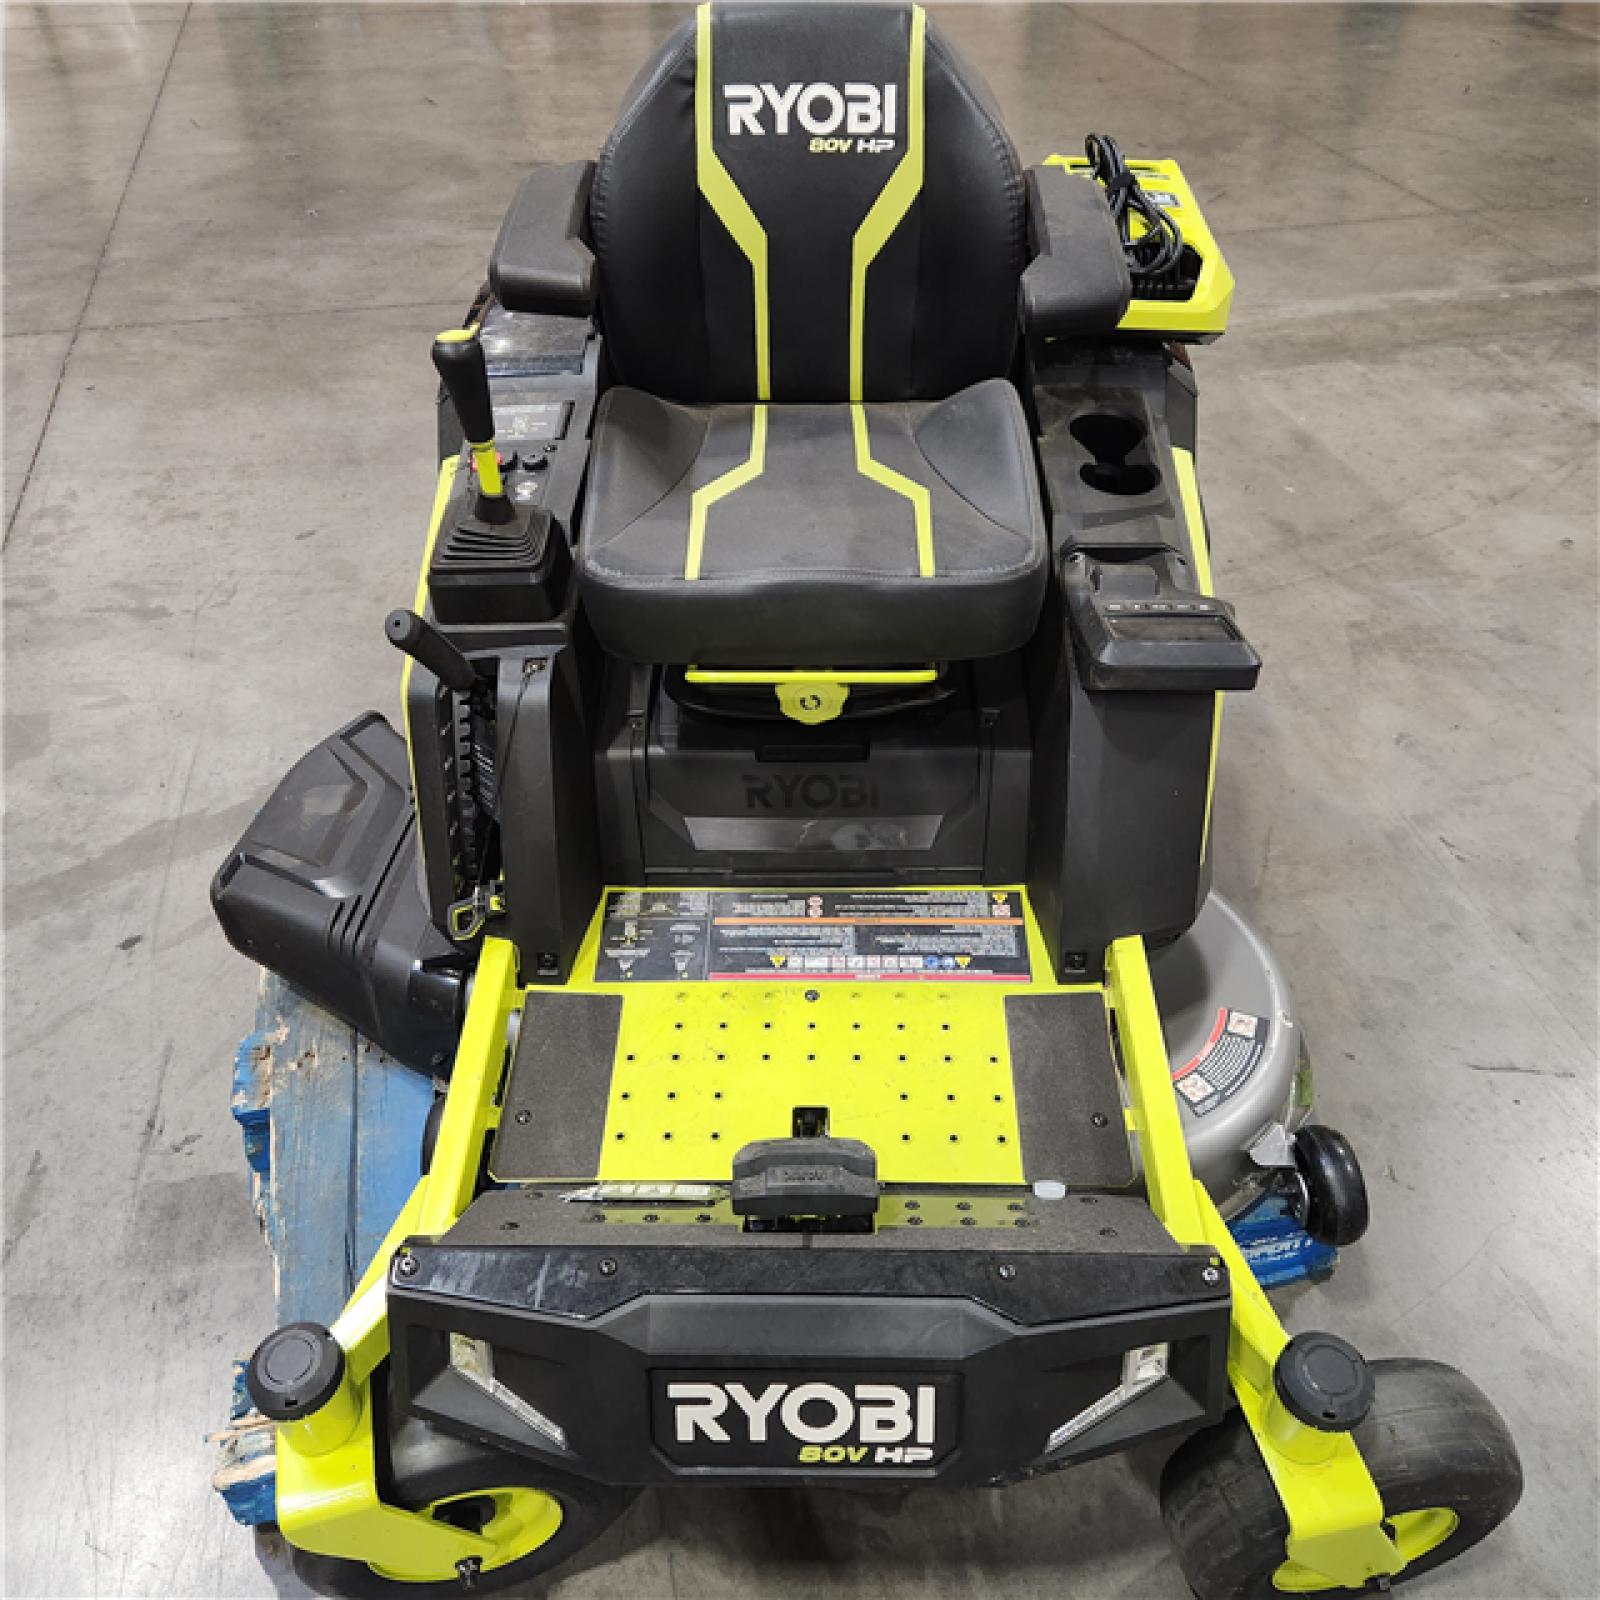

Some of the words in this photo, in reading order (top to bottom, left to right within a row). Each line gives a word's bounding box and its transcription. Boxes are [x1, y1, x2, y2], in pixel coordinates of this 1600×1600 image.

[723, 82, 897, 135] RYOBI
[808, 137, 852, 153] 80V
[856, 137, 896, 153] HP
[742, 774, 878, 809] RYOBI
[667, 1382, 936, 1443] RYOBI
[798, 1445, 868, 1463] 80V
[874, 1446, 934, 1463] HP
